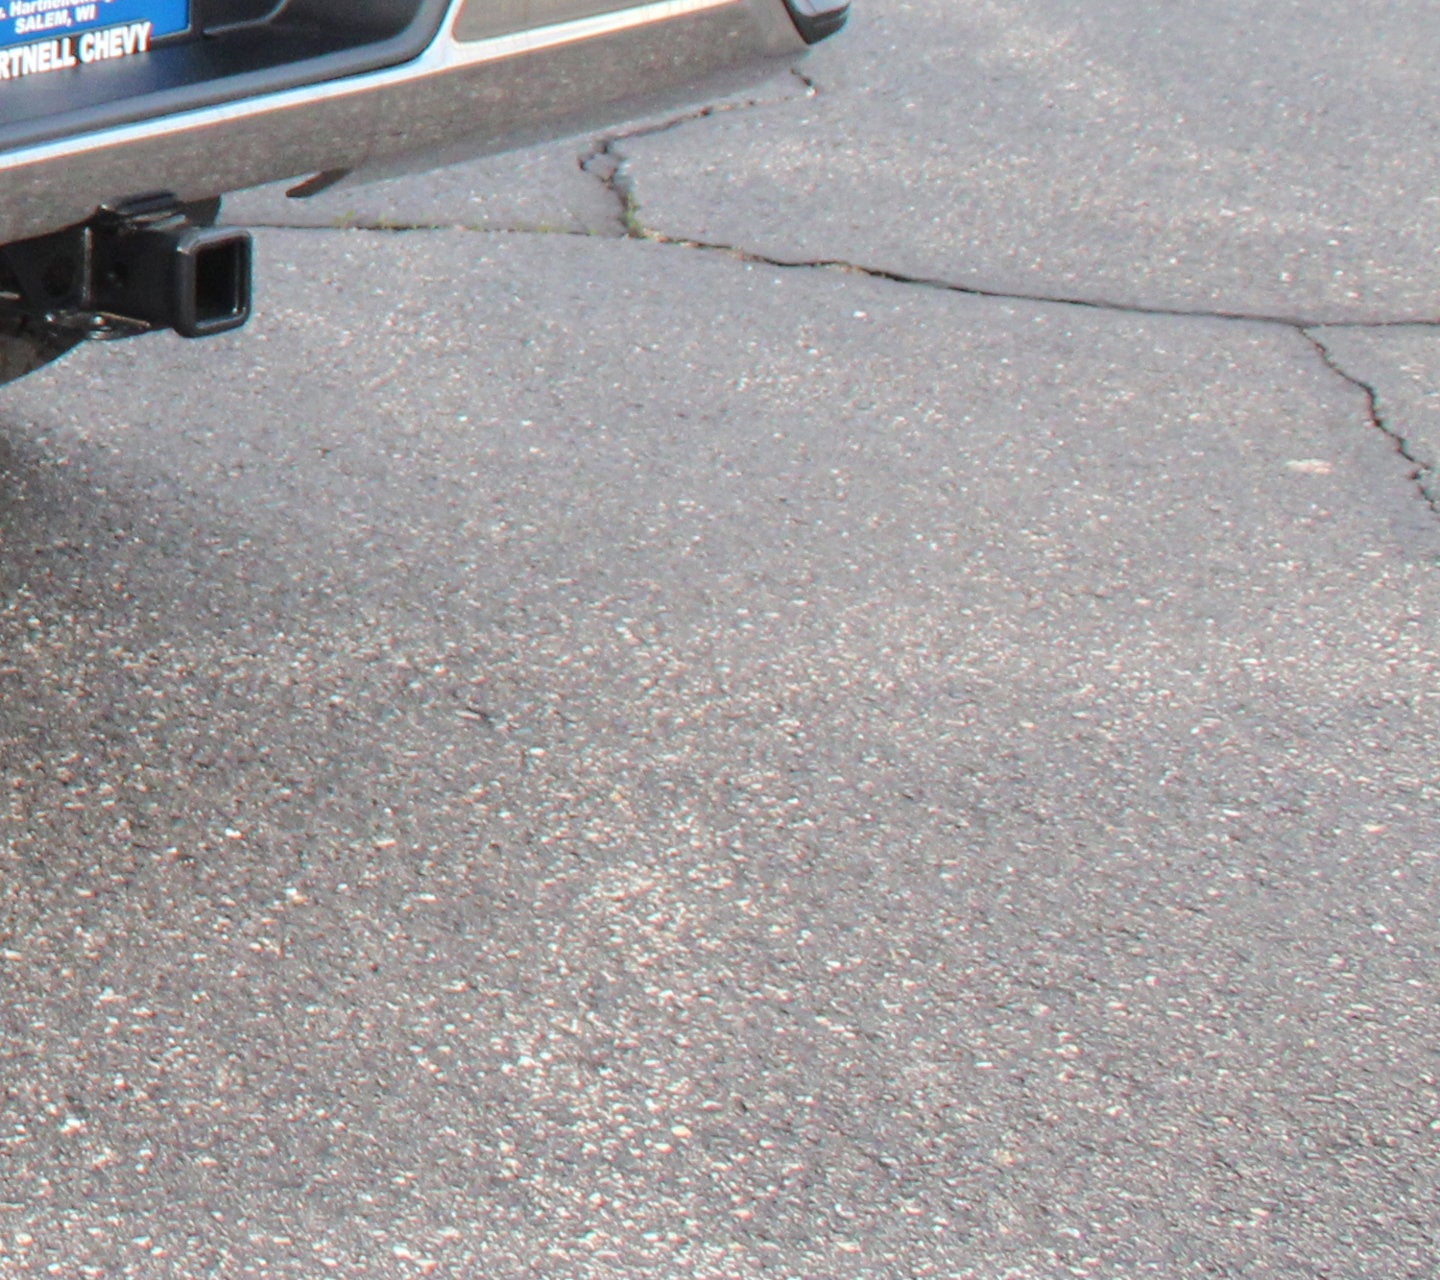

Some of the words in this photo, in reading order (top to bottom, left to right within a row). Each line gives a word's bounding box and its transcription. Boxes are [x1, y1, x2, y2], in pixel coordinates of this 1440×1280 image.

[14, 7, 73, 35] SALEM,
[74, 3, 98, 23] WI
[79, 21, 152, 64] CHEVY
